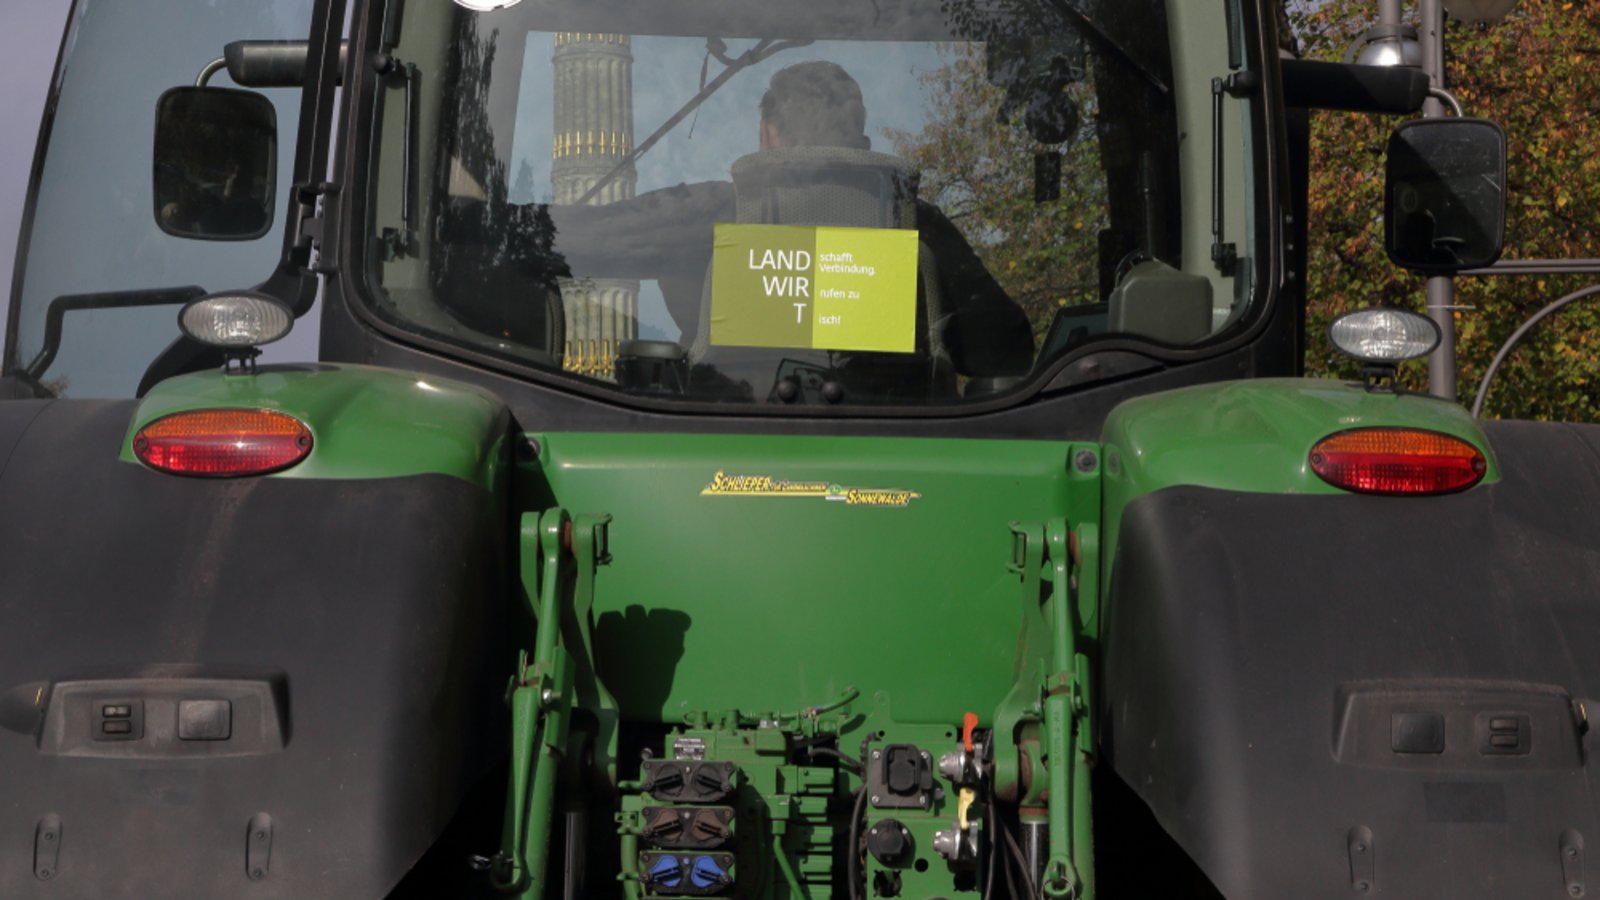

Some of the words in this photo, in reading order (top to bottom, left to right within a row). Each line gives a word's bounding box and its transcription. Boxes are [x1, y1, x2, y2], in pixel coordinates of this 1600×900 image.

[749, 249, 811, 271] LAND
[819, 252, 853, 263] schafft
[763, 276, 809, 297] WIR
[819, 288, 845, 299] rufen
[847, 291, 860, 299] zu
[793, 303, 807, 324] T
[819, 315, 841, 325] isch!
